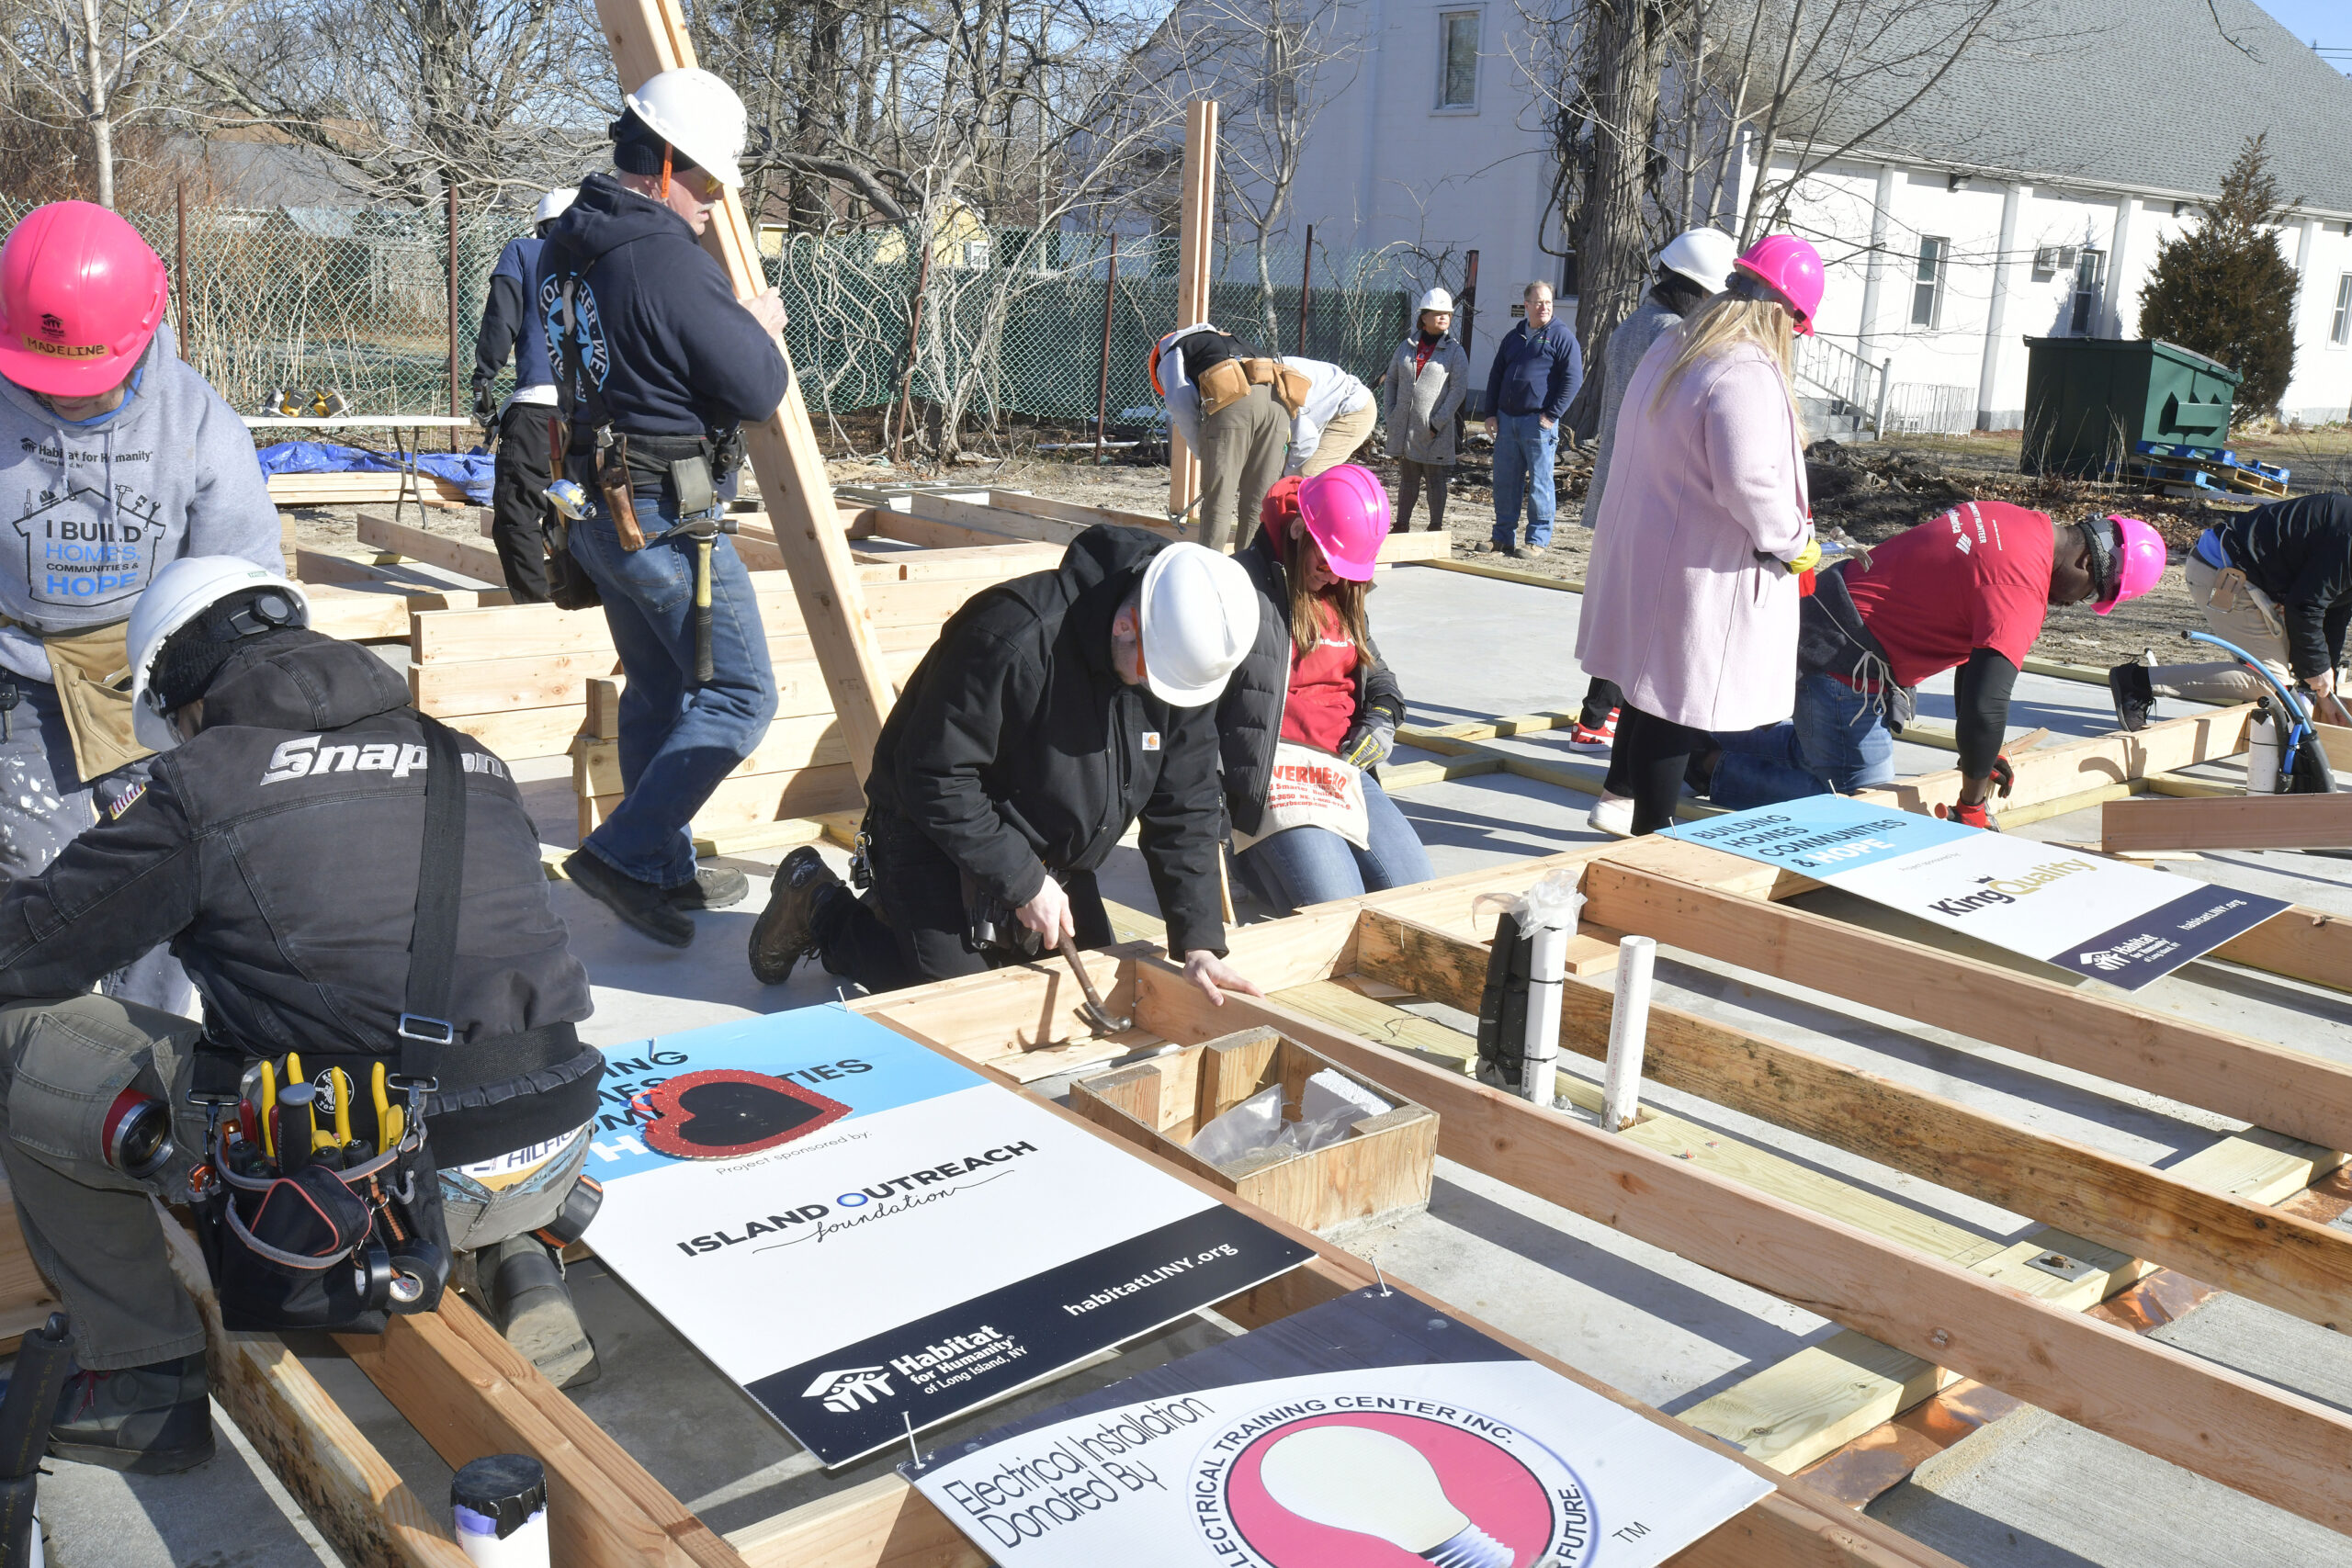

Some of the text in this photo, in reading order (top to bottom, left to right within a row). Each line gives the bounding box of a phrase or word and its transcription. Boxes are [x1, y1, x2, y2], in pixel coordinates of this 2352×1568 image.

[28, 337, 105, 356] MADELINE
[590, 339, 606, 374] WE
[40, 445, 151, 463] Habiat for Hmanity
[46, 520, 141, 543] I BUILD
[1974, 516, 1987, 544] VOLUNTEER
[46, 562, 129, 573] COMMUNITIES
[47, 572, 139, 597] HOPE
[1690, 814, 1792, 840] BUILDING
[1723, 825, 1810, 849] HOMES
[1758, 818, 1907, 857] COMMUNITIES
[1791, 838, 1897, 868] & HOPE
[2177, 899, 2247, 931] habitatLINY.org
[2110, 933, 2159, 955] Habitat
[716, 1130, 873, 1176] Project sponsored by:
[676, 1140, 1039, 1257] ISLAND OUTREACH
[1063, 1241, 1239, 1317] habitatLINY.org
[889, 1325, 1004, 1379] Habitat
[910, 1368, 938, 1386] for
[923, 1345, 1028, 1394] of Long Island, NY
[943, 1397, 1216, 1516] Electrical Installation
[1194, 1395, 1515, 1568] LECTRICAL TRAINING CENTER INC.
[978, 1461, 1168, 1549] Donated By
[1555, 1483, 1588, 1561] FUTURE.
[1611, 1520, 1652, 1543] TM
